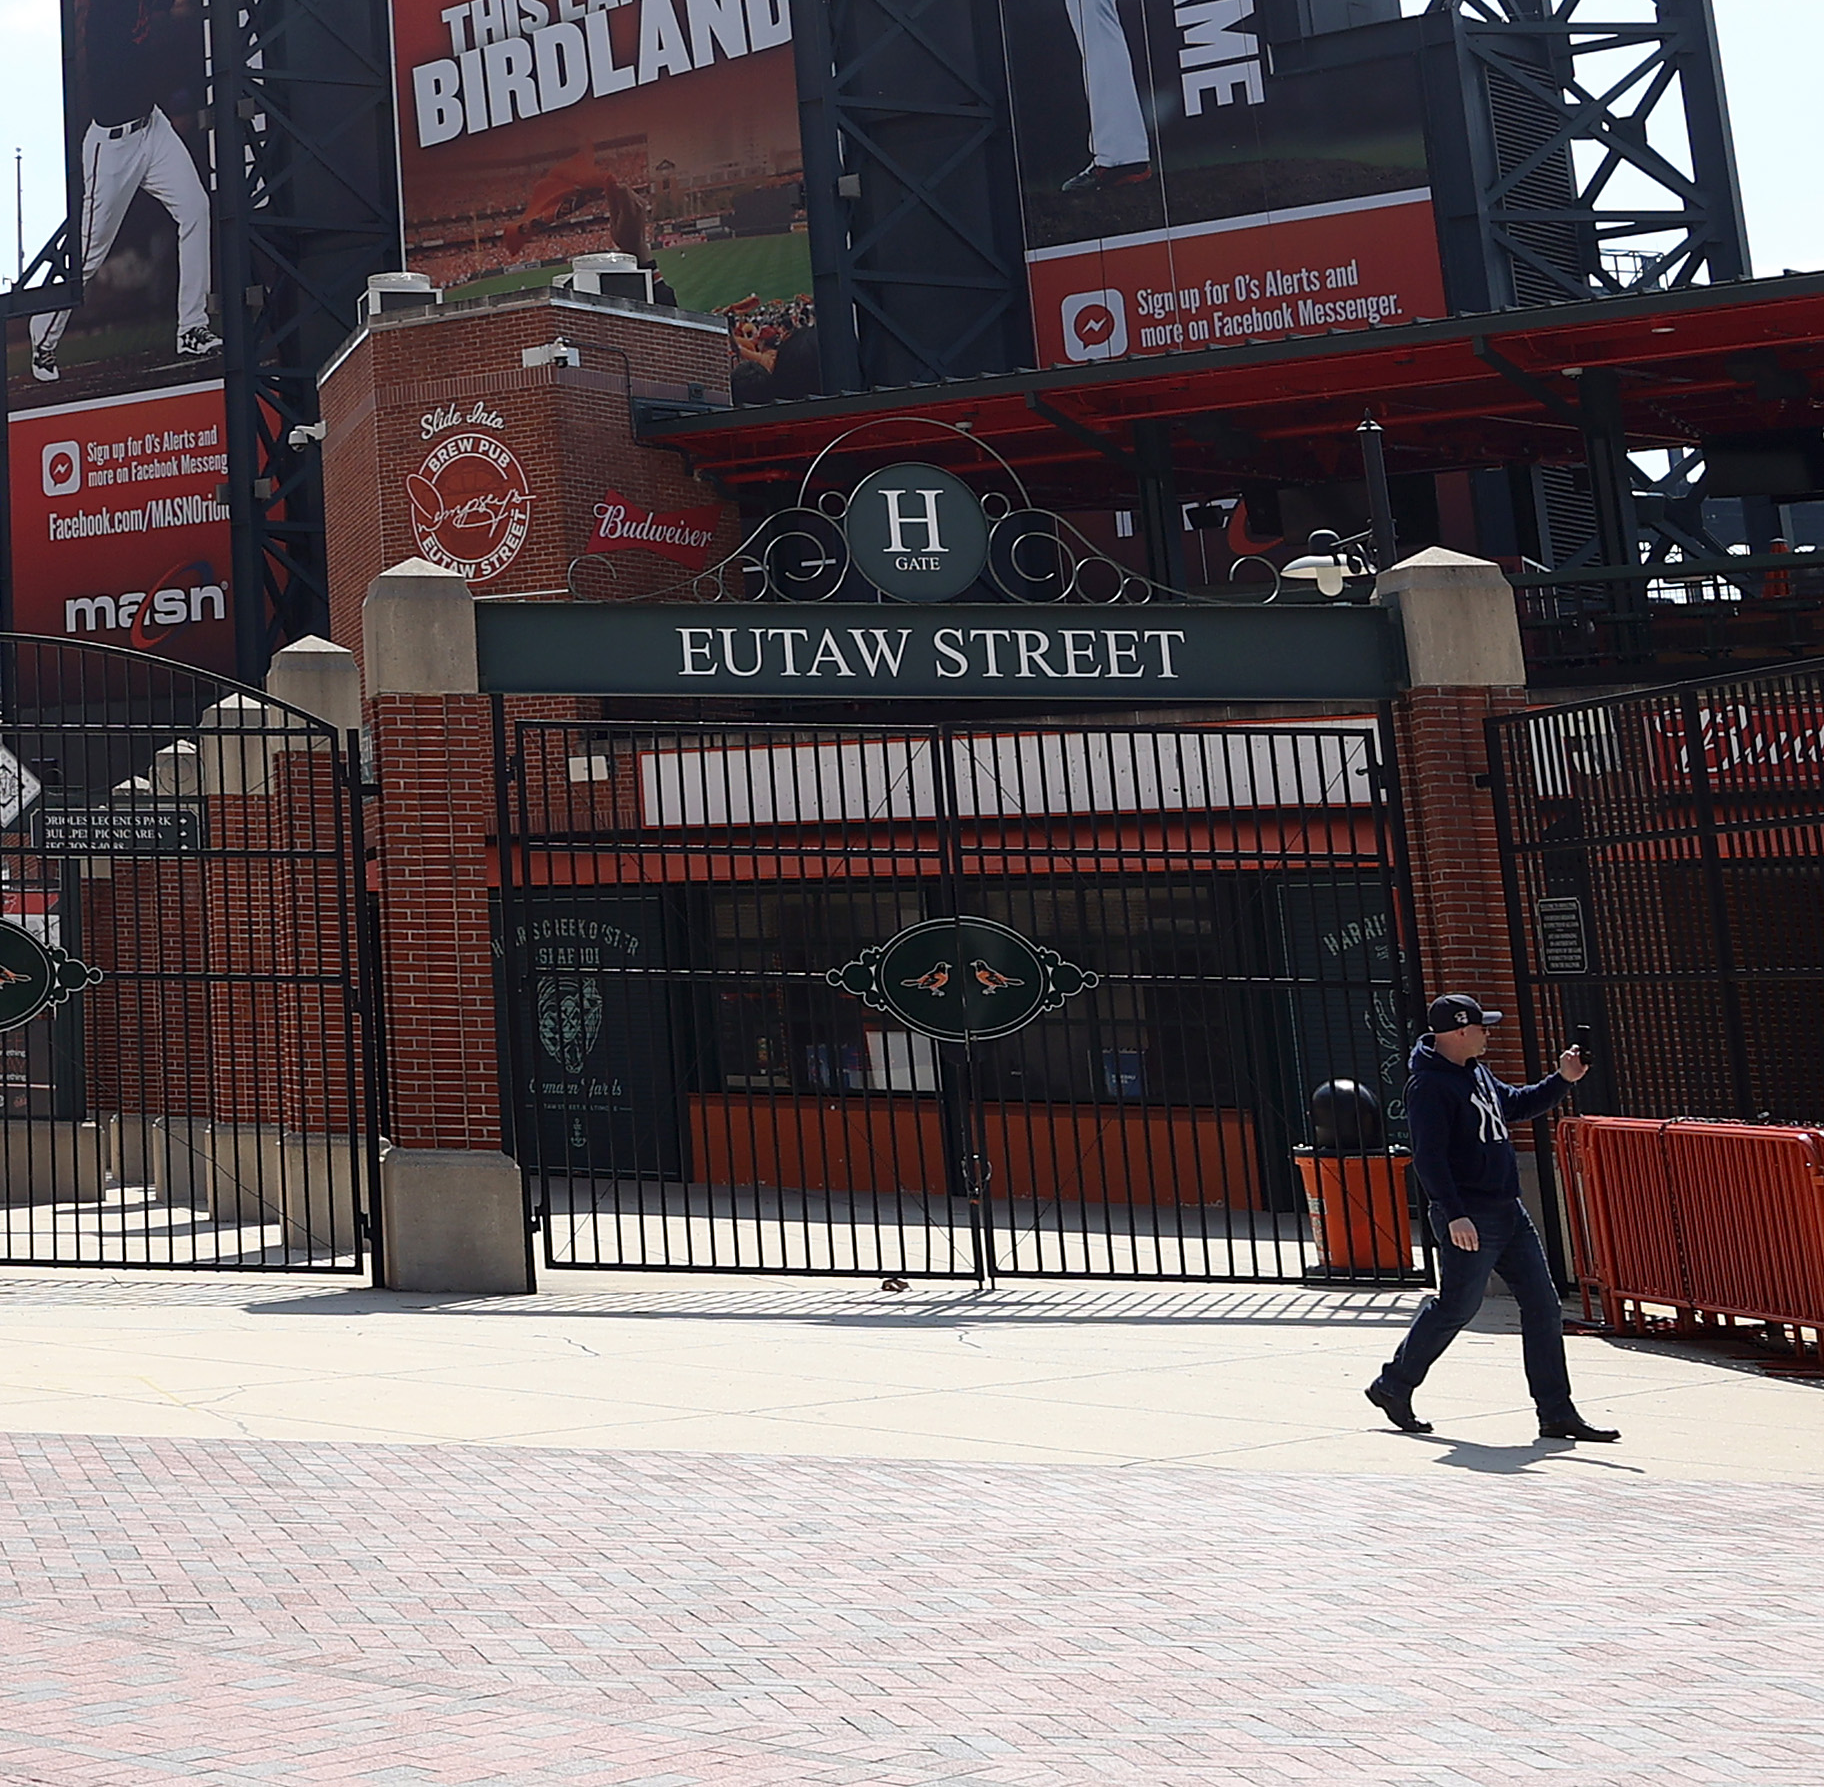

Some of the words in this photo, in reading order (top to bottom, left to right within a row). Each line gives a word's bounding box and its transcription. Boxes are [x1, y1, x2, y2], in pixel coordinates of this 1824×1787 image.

[1137, 289, 1175, 318] Sign
[1179, 286, 1200, 313] up
[1204, 279, 1230, 306] for
[1234, 275, 1261, 301] O's
[1266, 267, 1321, 298] Alerts
[1325, 259, 1359, 289] and
[1141, 322, 1184, 348] more
[1188, 319, 1210, 341] on
[1214, 302, 1295, 338] Facebook
[1298, 292, 1403, 324] Messenger.
[87, 441, 110, 465] Sign
[112, 443, 125, 461] up
[127, 436, 142, 455] for
[144, 433, 161, 453] O's
[163, 427, 195, 452] Alerts
[197, 424, 218, 447] and
[420, 402, 462, 442] Slide
[466, 399, 505, 431] Into
[88, 469, 114, 487] more
[116, 466, 129, 484] on
[131, 457, 179, 482] Facebook
[427, 438, 474, 473] BREW
[478, 438, 511, 469] PUB
[480, 509, 527, 577] STREET
[593, 502, 713, 549] Budweiser
[876, 488, 950, 556] H
[894, 556, 941, 572] GATE
[66, 582, 226, 633] masn
[676, 627, 915, 679] EUTAW
[935, 629, 1187, 681] STREET
